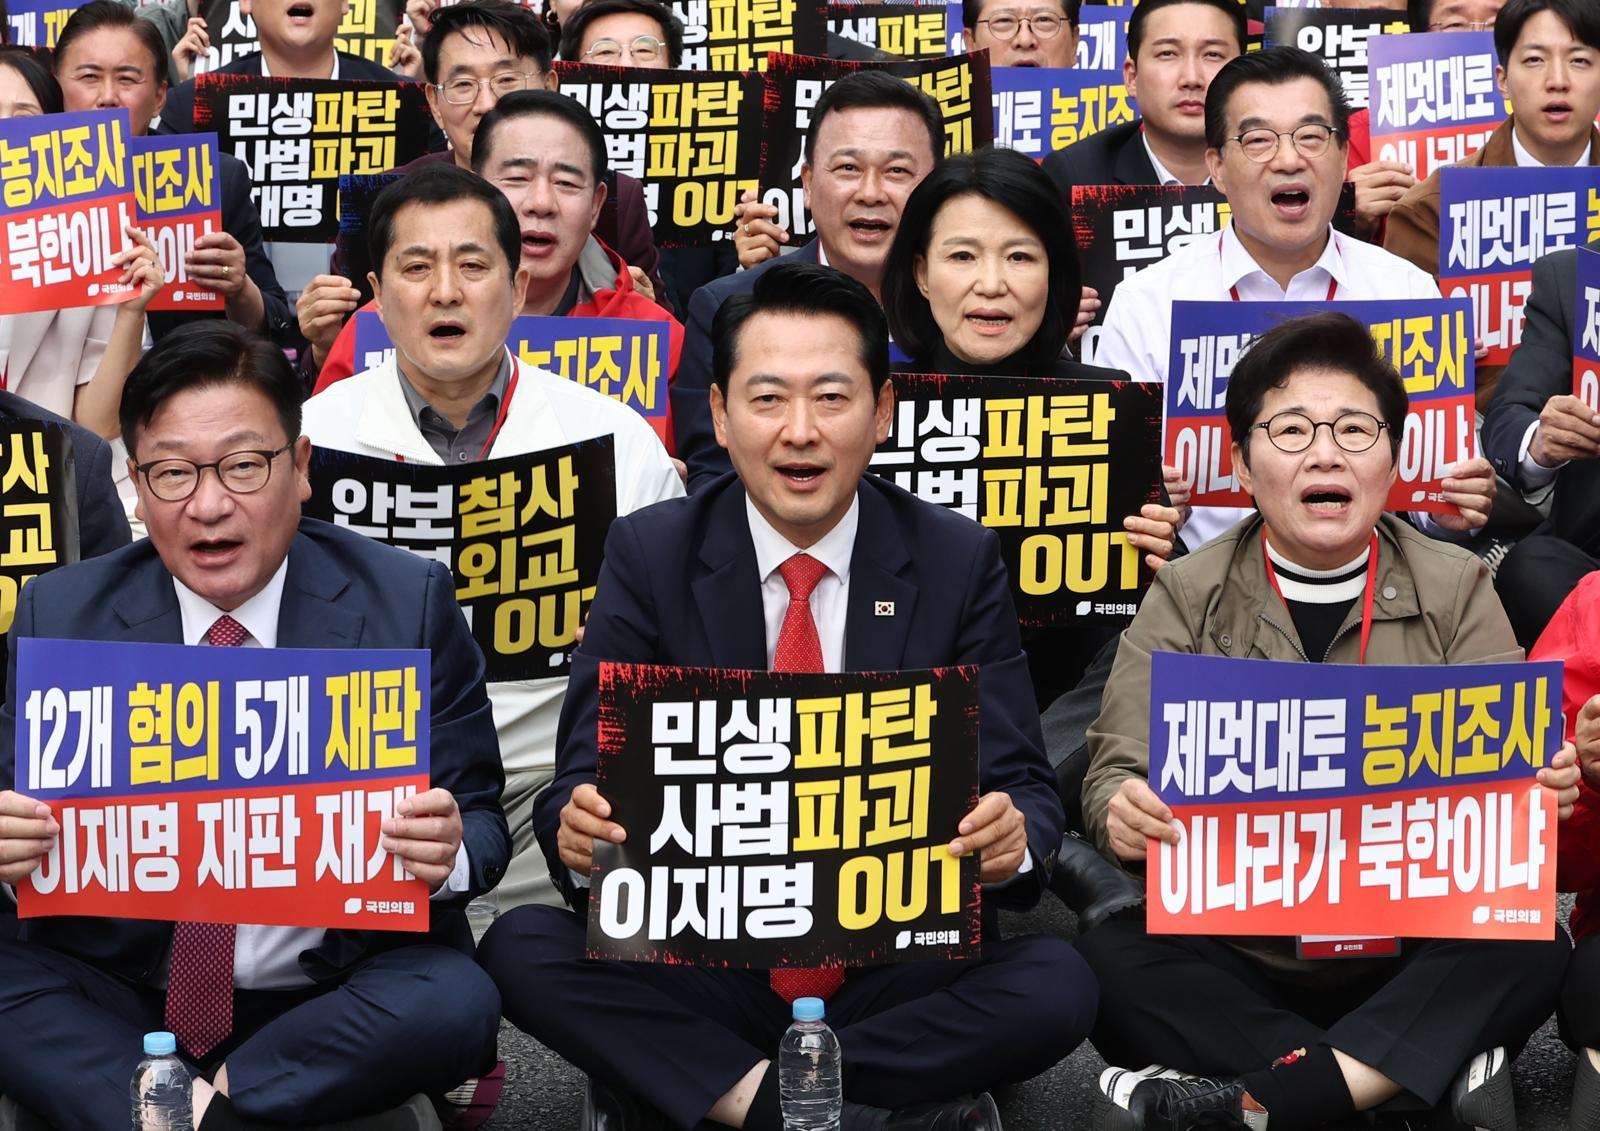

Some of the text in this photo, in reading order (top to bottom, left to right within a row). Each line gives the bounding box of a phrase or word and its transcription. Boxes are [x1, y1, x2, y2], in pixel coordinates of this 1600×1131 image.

[670, 0, 796, 44] 생파탄
[1297, 21, 1410, 68] 안보
[228, 90, 400, 136] 민생파탄
[1376, 53, 1495, 128] 제멋대로
[0, 120, 126, 208] 농지조사
[132, 143, 213, 214] 지조사
[603, 130, 738, 178] 법파괴
[249, 185, 323, 228] 재명
[1449, 191, 1576, 270] 제멋대로
[1395, 403, 1468, 482] 이냐
[331, 454, 579, 540] 안보참사
[878, 462, 1109, 528] 법파괴
[1019, 531, 1140, 596] OUT
[493, 586, 597, 655] OU
[1094, 602, 1137, 615] 국민의힘
[25, 667, 421, 790] 12개 혐의 5개 재판
[651, 684, 937, 776] 민생파탄
[1160, 677, 1551, 797] 제멋대로 농지조사
[30, 802, 180, 895] 이재명
[197, 794, 301, 890] 재판
[650, 765, 931, 858] 사법파괴
[1159, 788, 1546, 915] 이나라가 북한이냐
[365, 899, 415, 914] 국민의힘
[599, 844, 974, 941] 이재명 OUT
[1493, 907, 1542, 924] 국민의힘
[914, 930, 960, 947] 국민의힘
